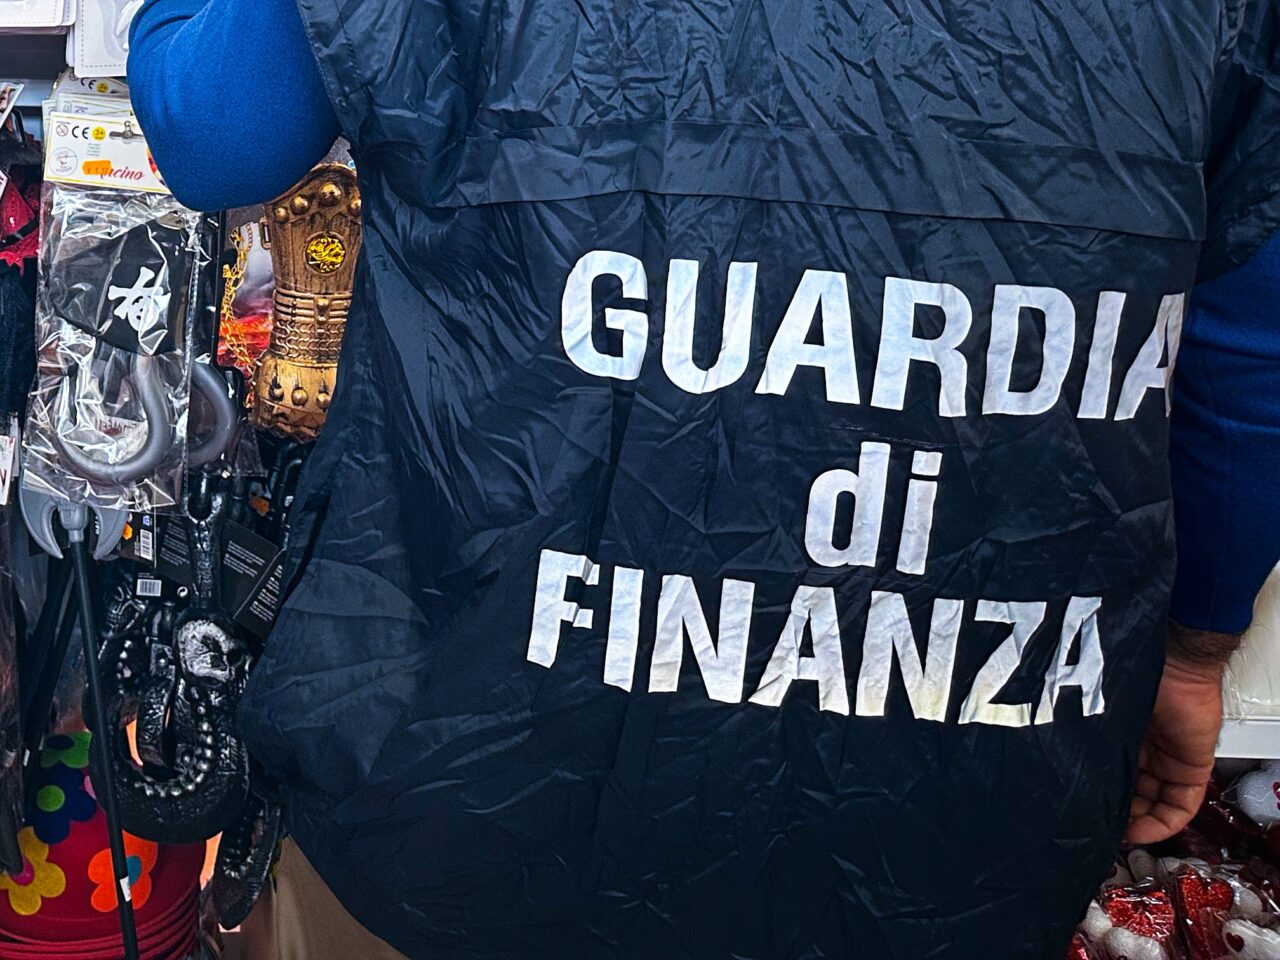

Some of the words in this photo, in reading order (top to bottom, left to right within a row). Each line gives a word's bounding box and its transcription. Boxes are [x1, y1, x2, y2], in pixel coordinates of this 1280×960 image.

[560, 249, 1187, 422] GUARDIA
[803, 440, 943, 576] di
[526, 548, 1106, 729] FINANZA
